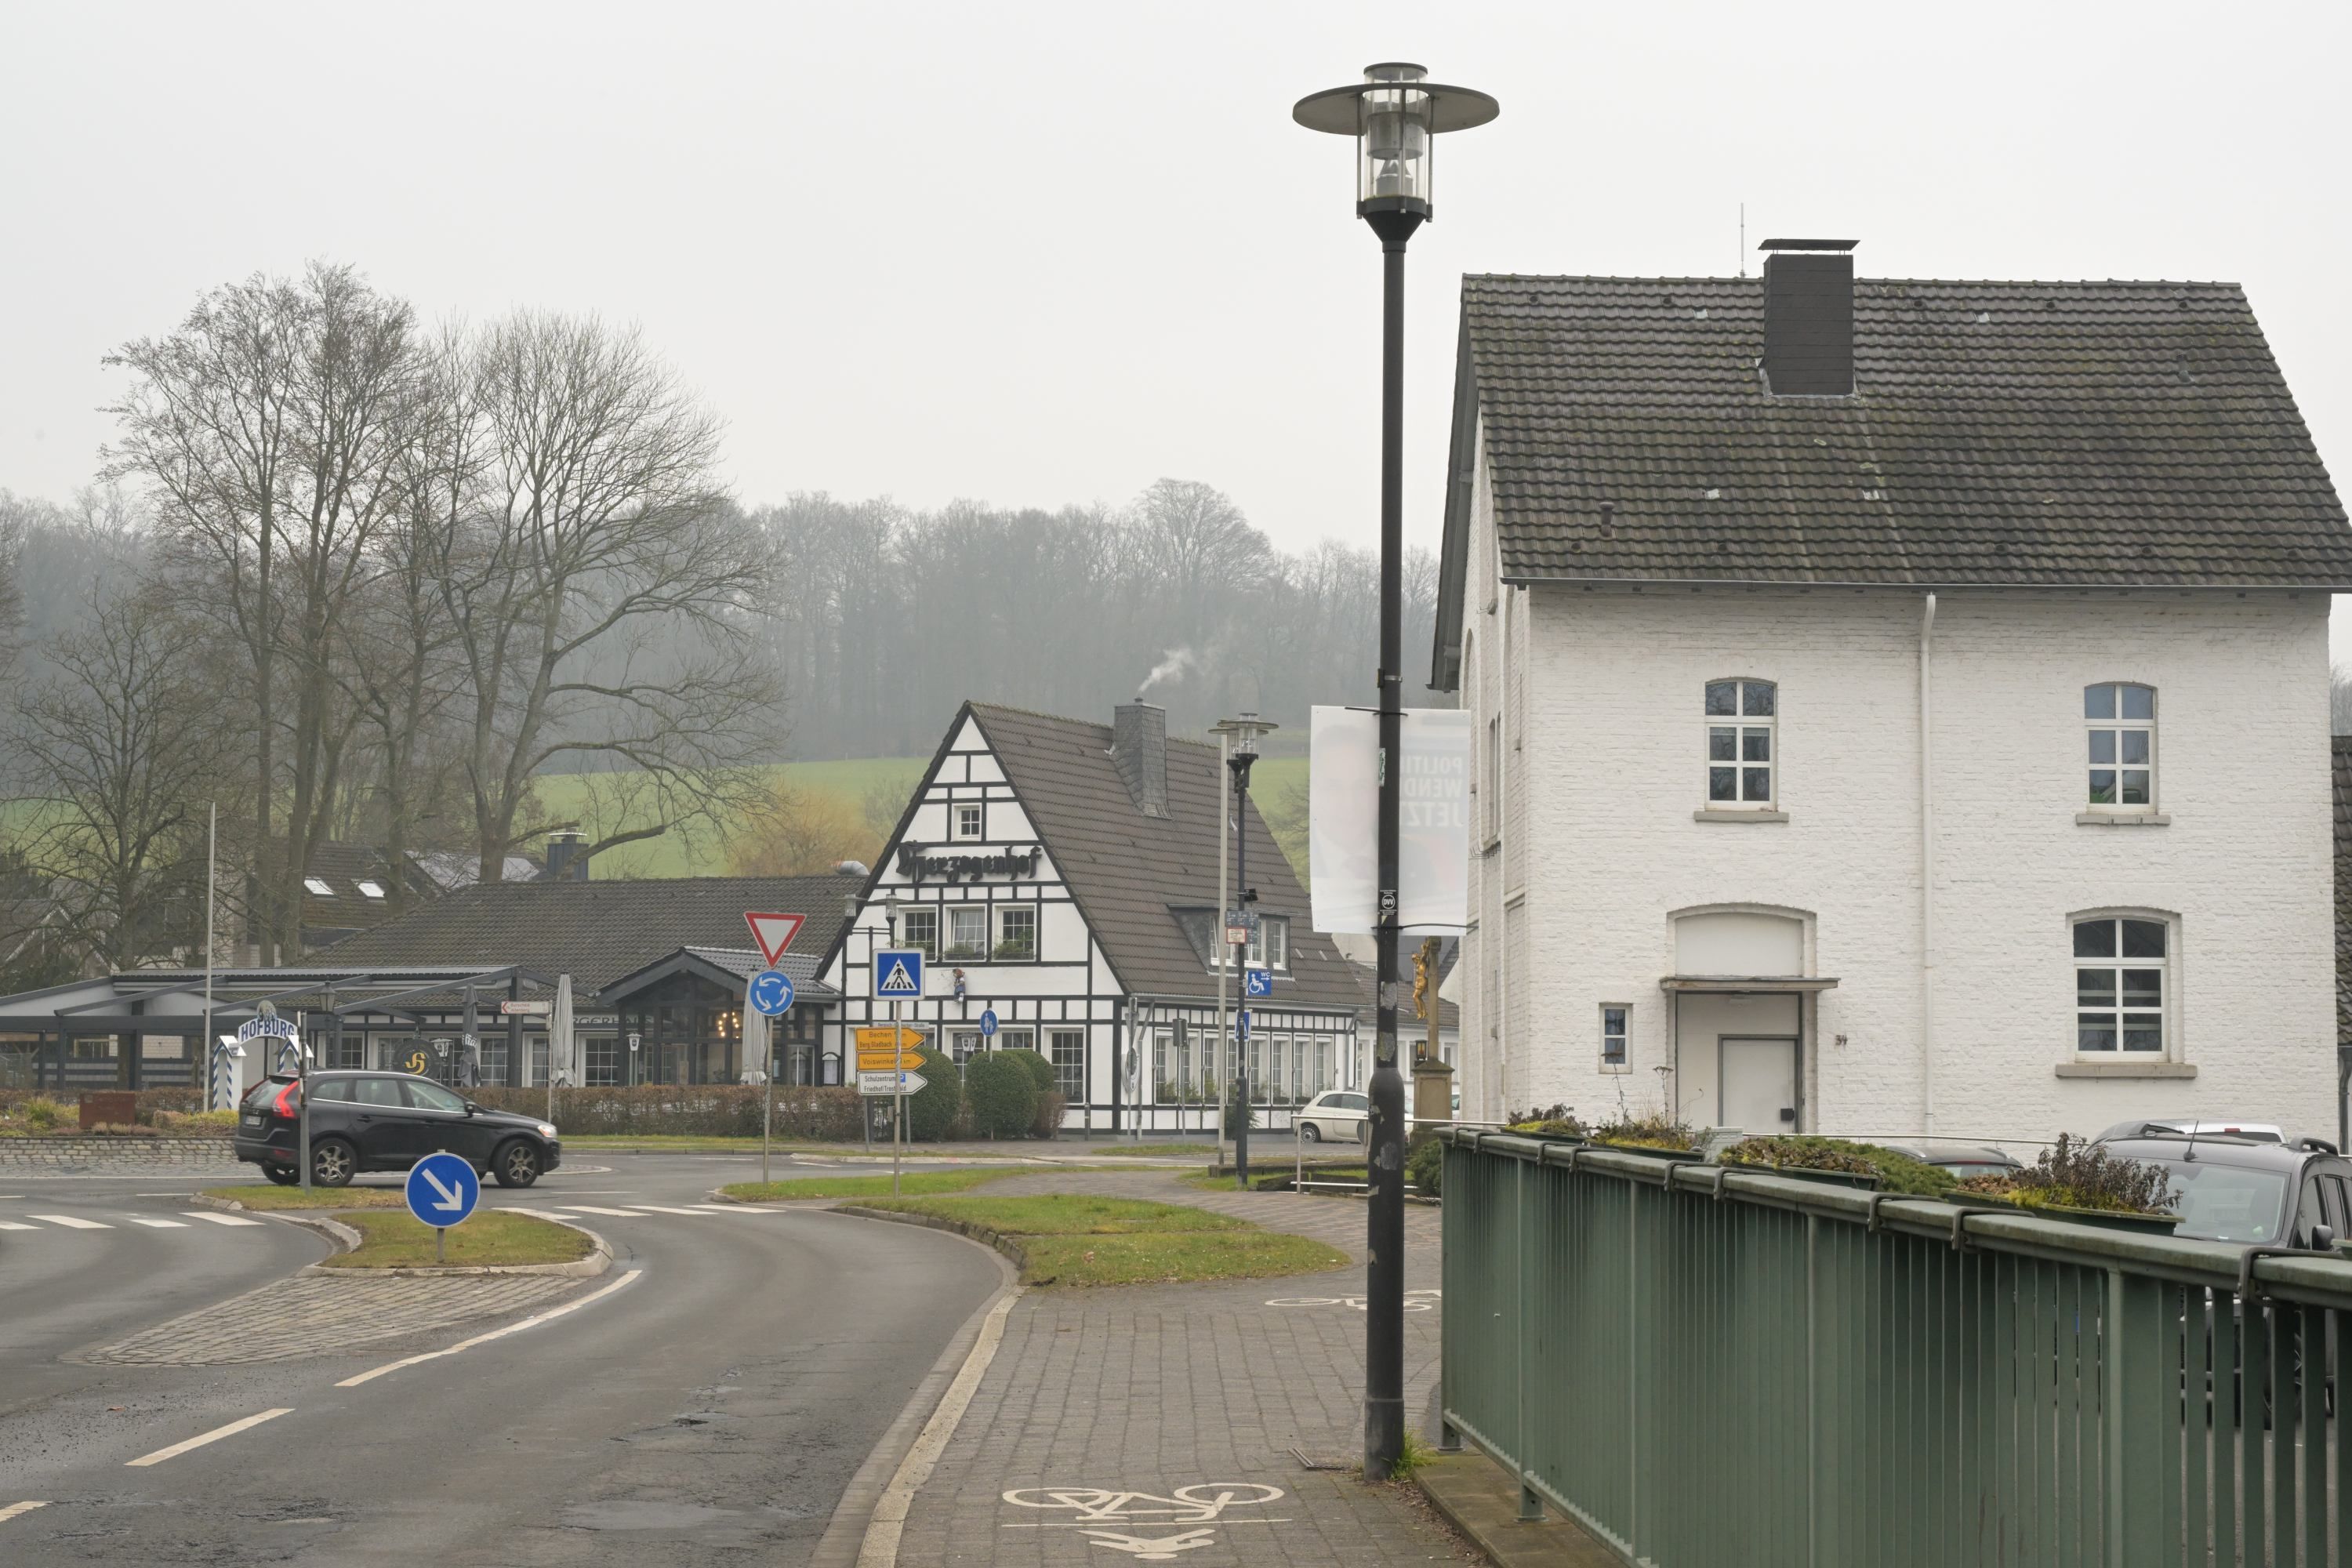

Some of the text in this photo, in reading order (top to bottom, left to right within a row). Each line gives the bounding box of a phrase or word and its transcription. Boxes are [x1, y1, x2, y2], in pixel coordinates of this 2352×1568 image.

[896, 840, 1042, 884] Herzogenhof
[241, 1020, 294, 1042] HOFBURG
[1835, 1034, 1848, 1046] 34
